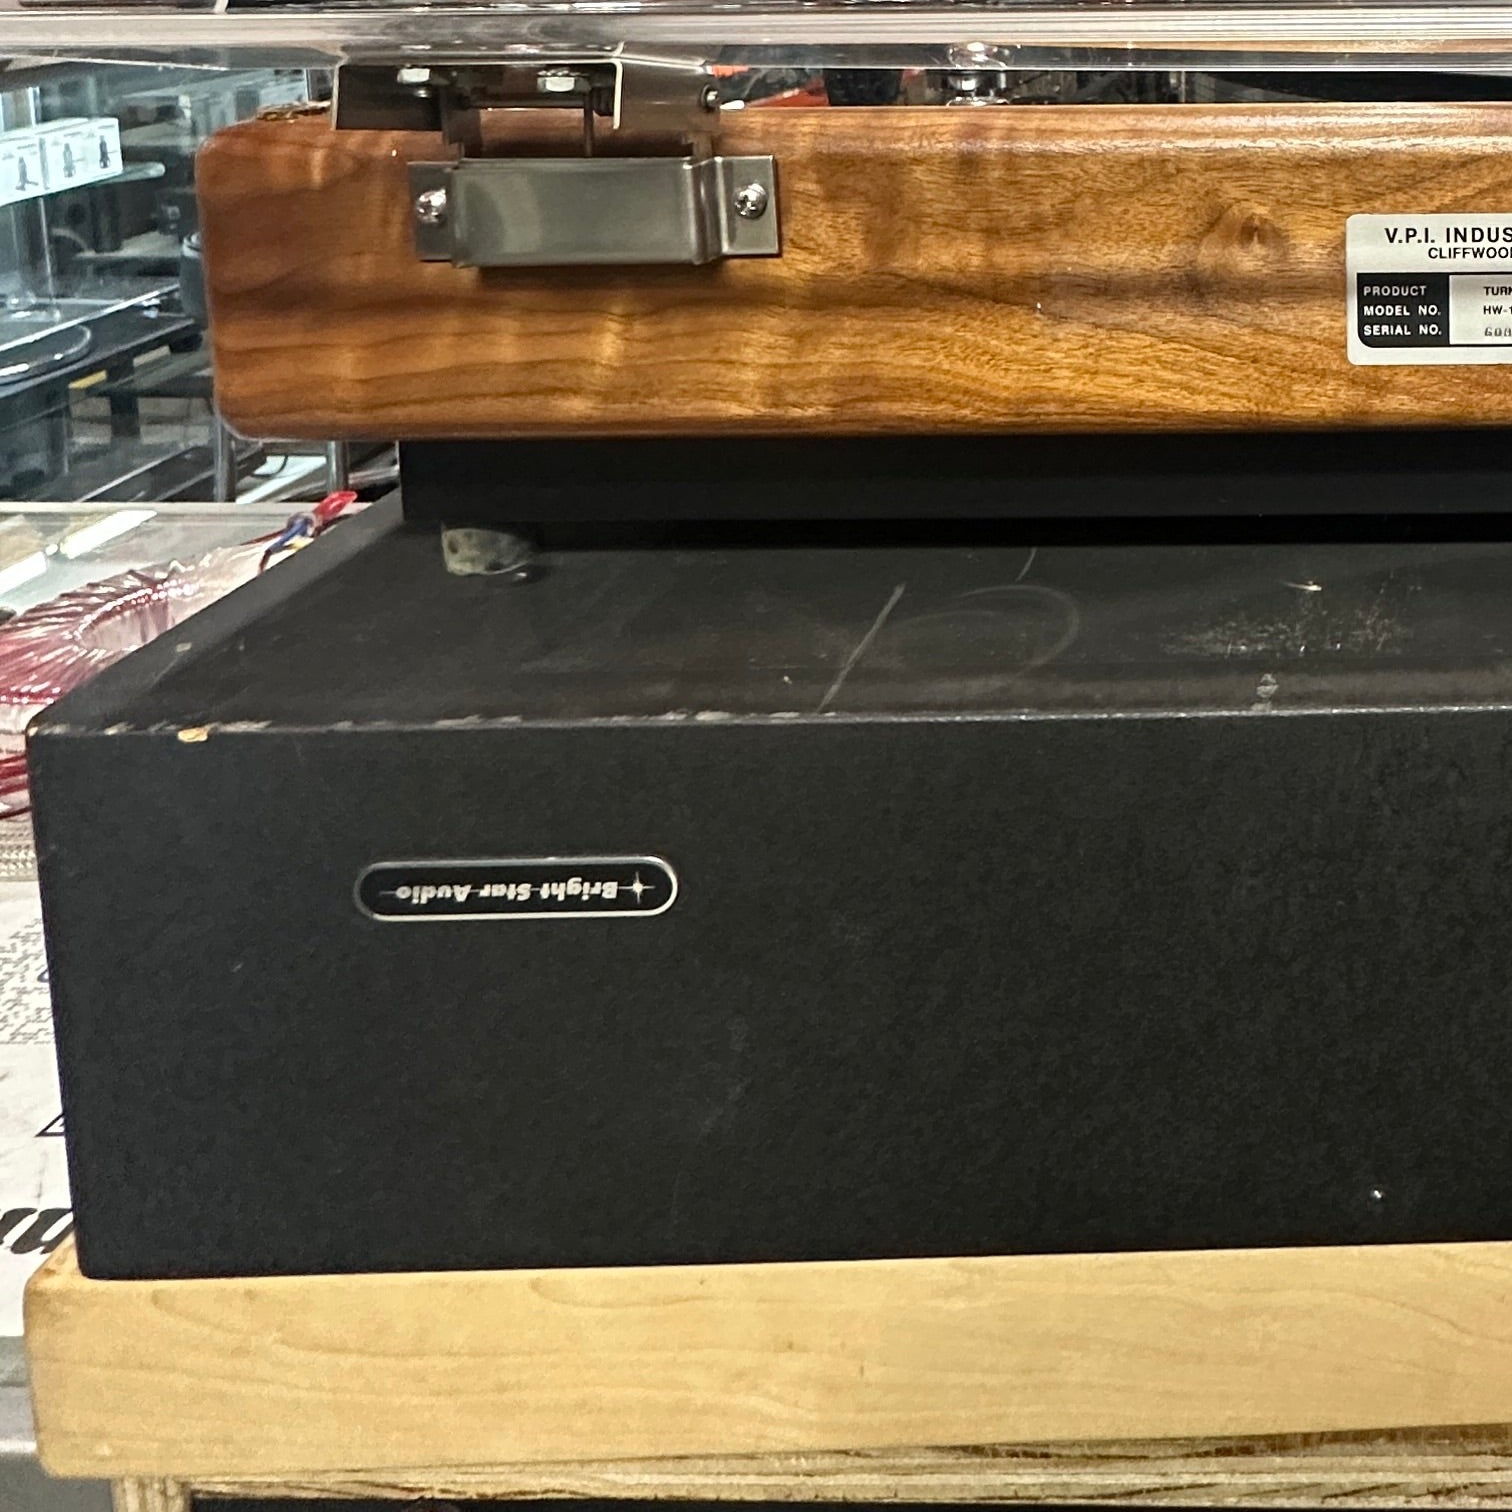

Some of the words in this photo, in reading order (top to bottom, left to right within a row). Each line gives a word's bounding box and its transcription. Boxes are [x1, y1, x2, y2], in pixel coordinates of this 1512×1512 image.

[1384, 227, 1436, 245] V.P.I.
[1363, 285, 1427, 297] PRODUCT
[1363, 304, 1411, 317] MODEL
[1418, 304, 1442, 316] NO.
[1363, 323, 1412, 337] SERIAL
[1418, 323, 1443, 336] NO.
[395, 883, 473, 904] Audio
[479, 882, 531, 902] Star
[539, 878, 619, 902] Bright
